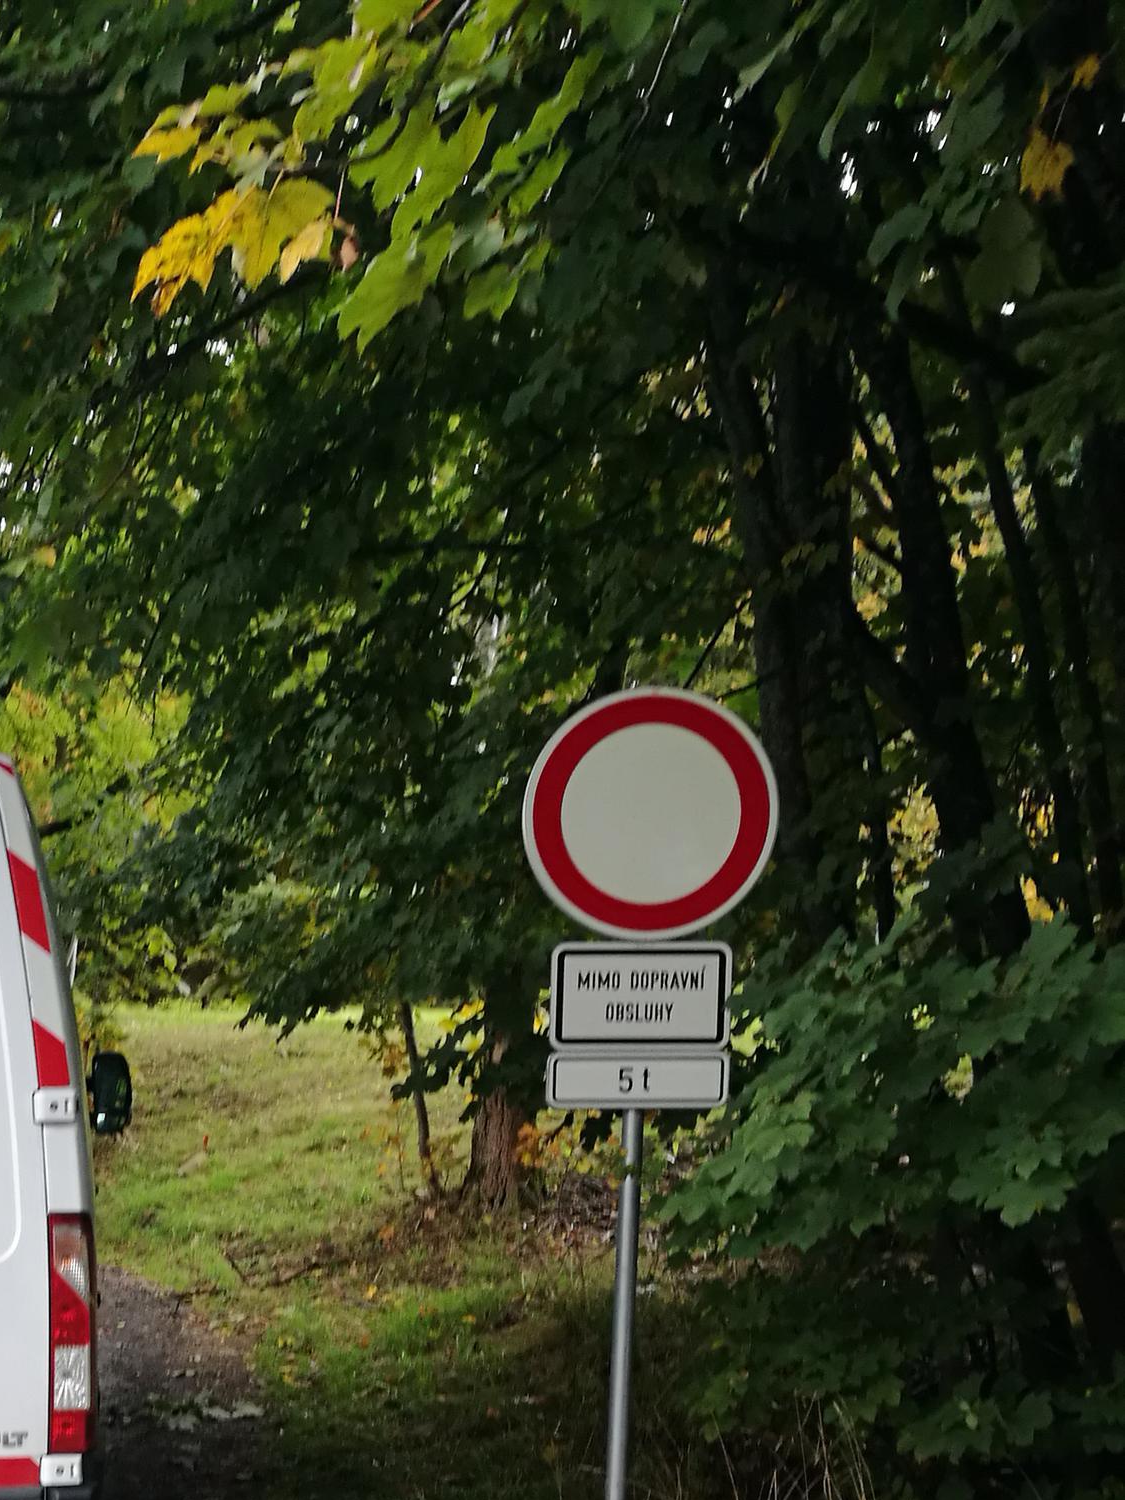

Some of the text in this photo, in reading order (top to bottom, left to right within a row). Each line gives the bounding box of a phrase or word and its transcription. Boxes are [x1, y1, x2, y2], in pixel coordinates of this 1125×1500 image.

[577, 965, 706, 991] MIMO DOPRAVNÍ
[605, 1002, 674, 1023] OBSLUHY
[618, 1066, 651, 1094] 5 t
